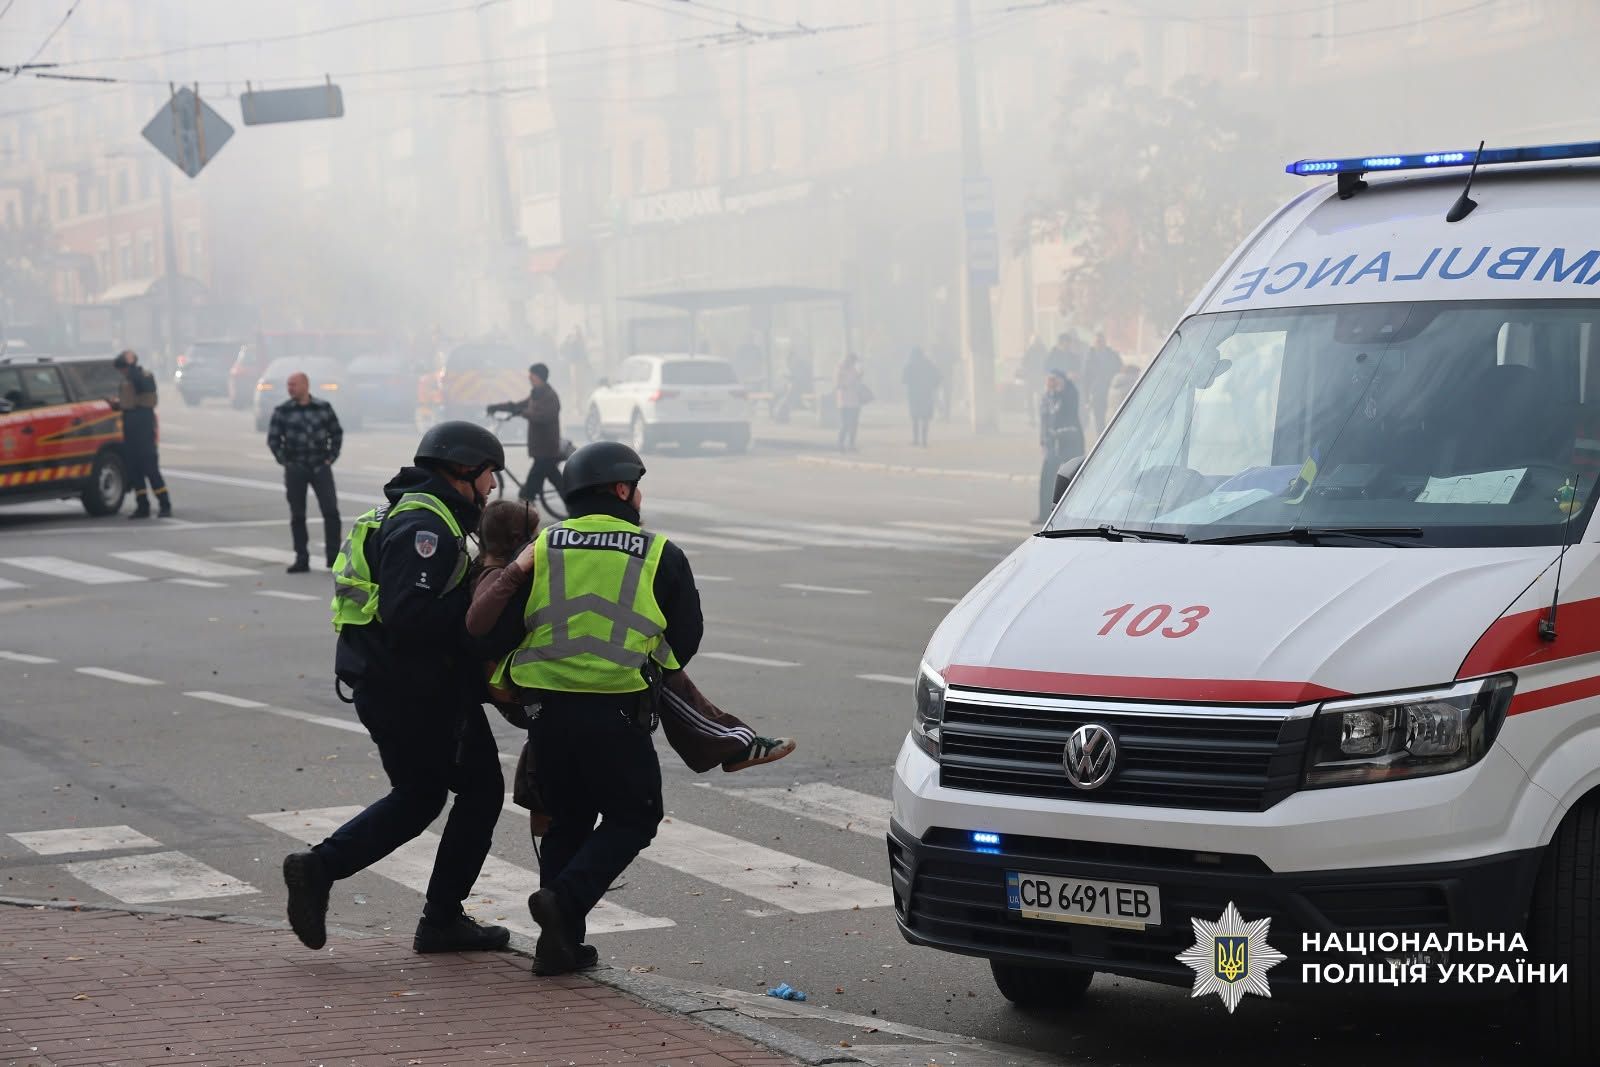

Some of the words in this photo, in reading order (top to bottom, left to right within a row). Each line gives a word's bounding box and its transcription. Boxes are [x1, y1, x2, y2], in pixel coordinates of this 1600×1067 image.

[552, 529, 645, 555] ПОЛІЦІЯ
[1096, 603, 1211, 639] 103
[1009, 896, 1020, 904] UA
